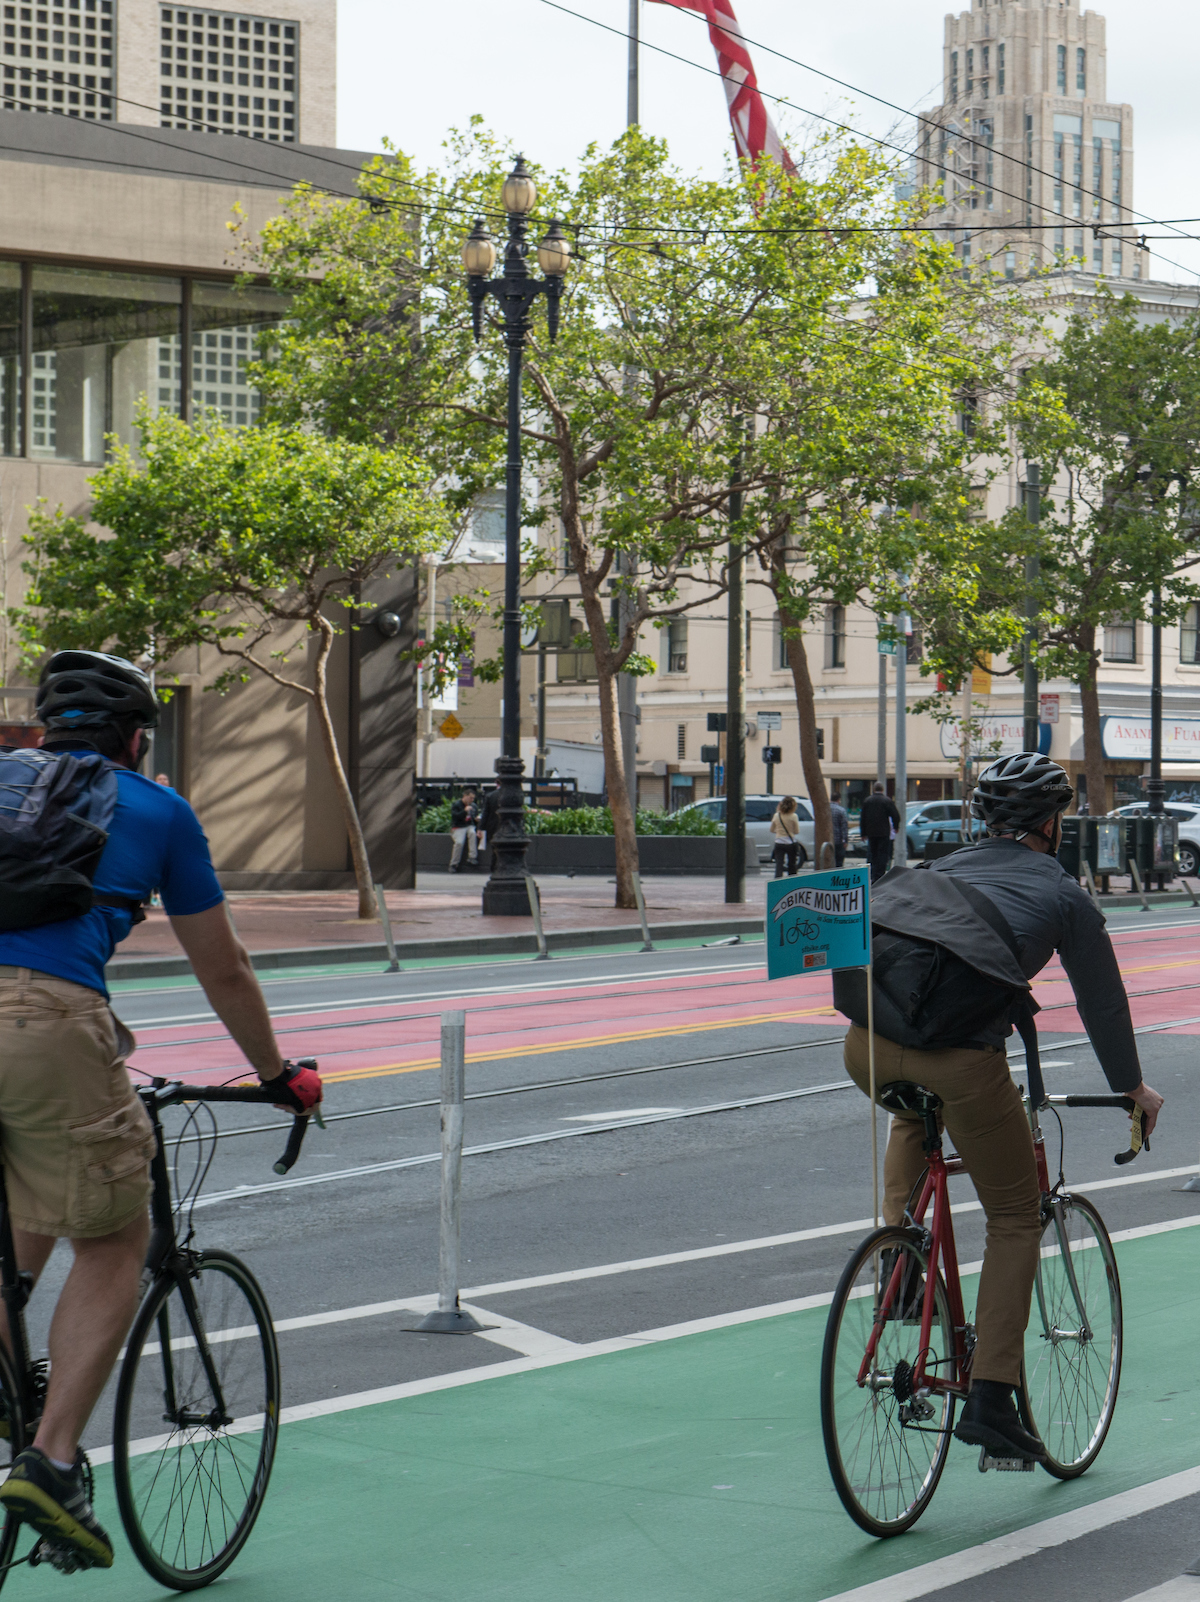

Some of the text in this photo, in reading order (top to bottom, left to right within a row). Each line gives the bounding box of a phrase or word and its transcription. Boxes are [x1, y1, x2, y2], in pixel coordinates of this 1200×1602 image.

[830, 874, 861, 889] May is
[787, 890, 859, 912] BIKE MONTH
[822, 916, 833, 924] San
